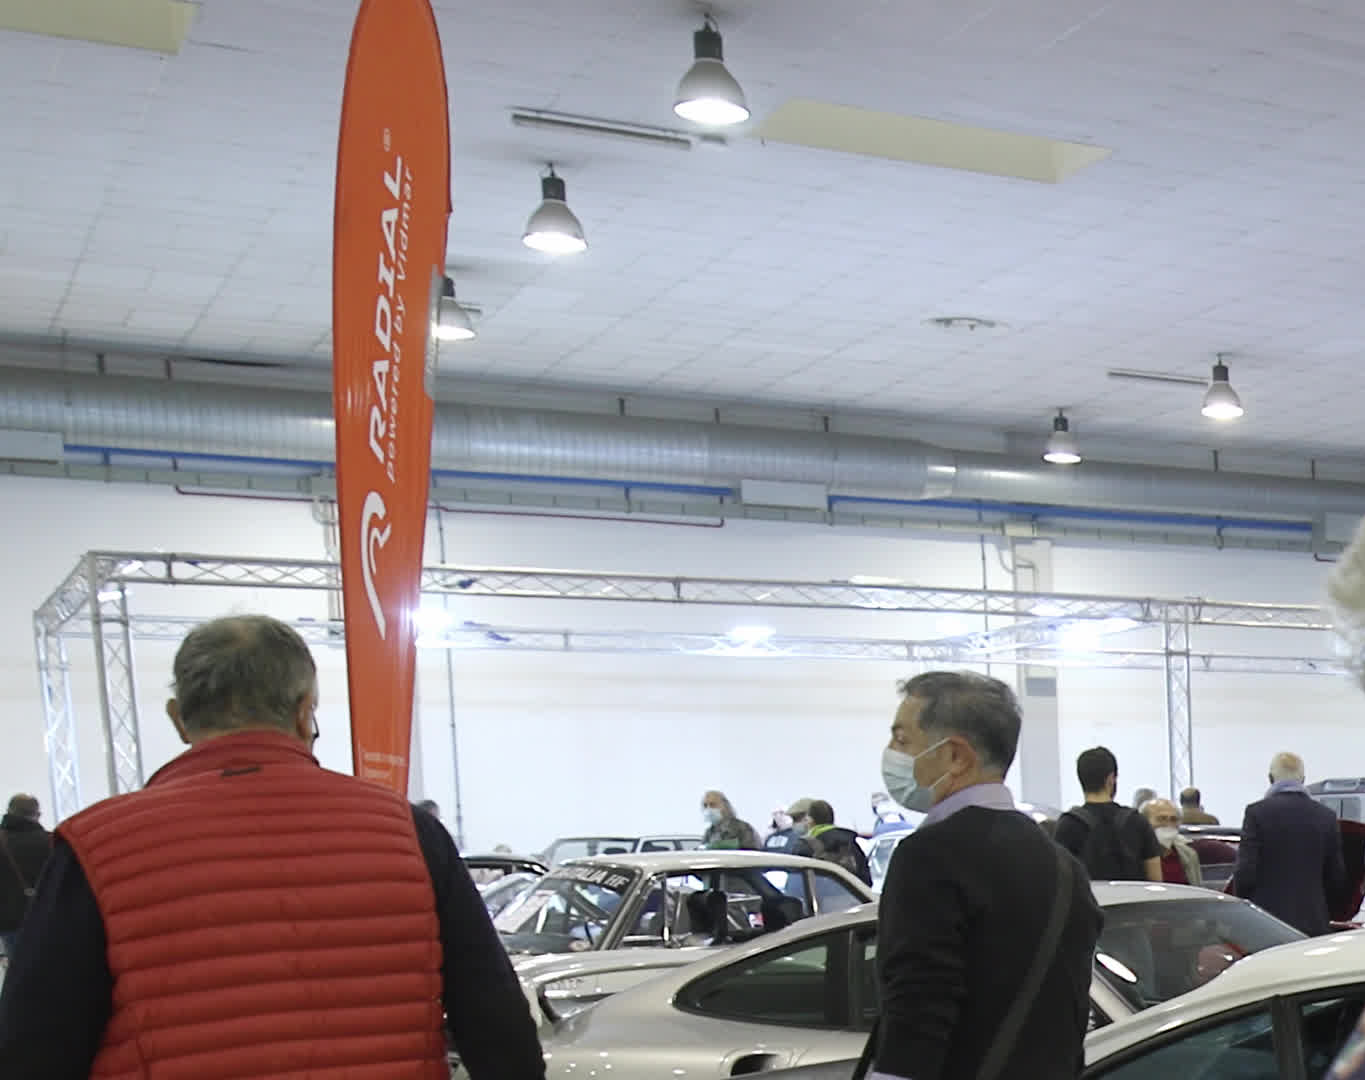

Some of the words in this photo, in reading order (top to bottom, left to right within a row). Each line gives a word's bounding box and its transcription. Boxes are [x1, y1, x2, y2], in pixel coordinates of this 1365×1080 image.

[397, 166, 413, 281] Vidmar
[369, 156, 402, 464] RADIAL
[393, 297, 407, 335] by
[385, 342, 401, 484] powered
